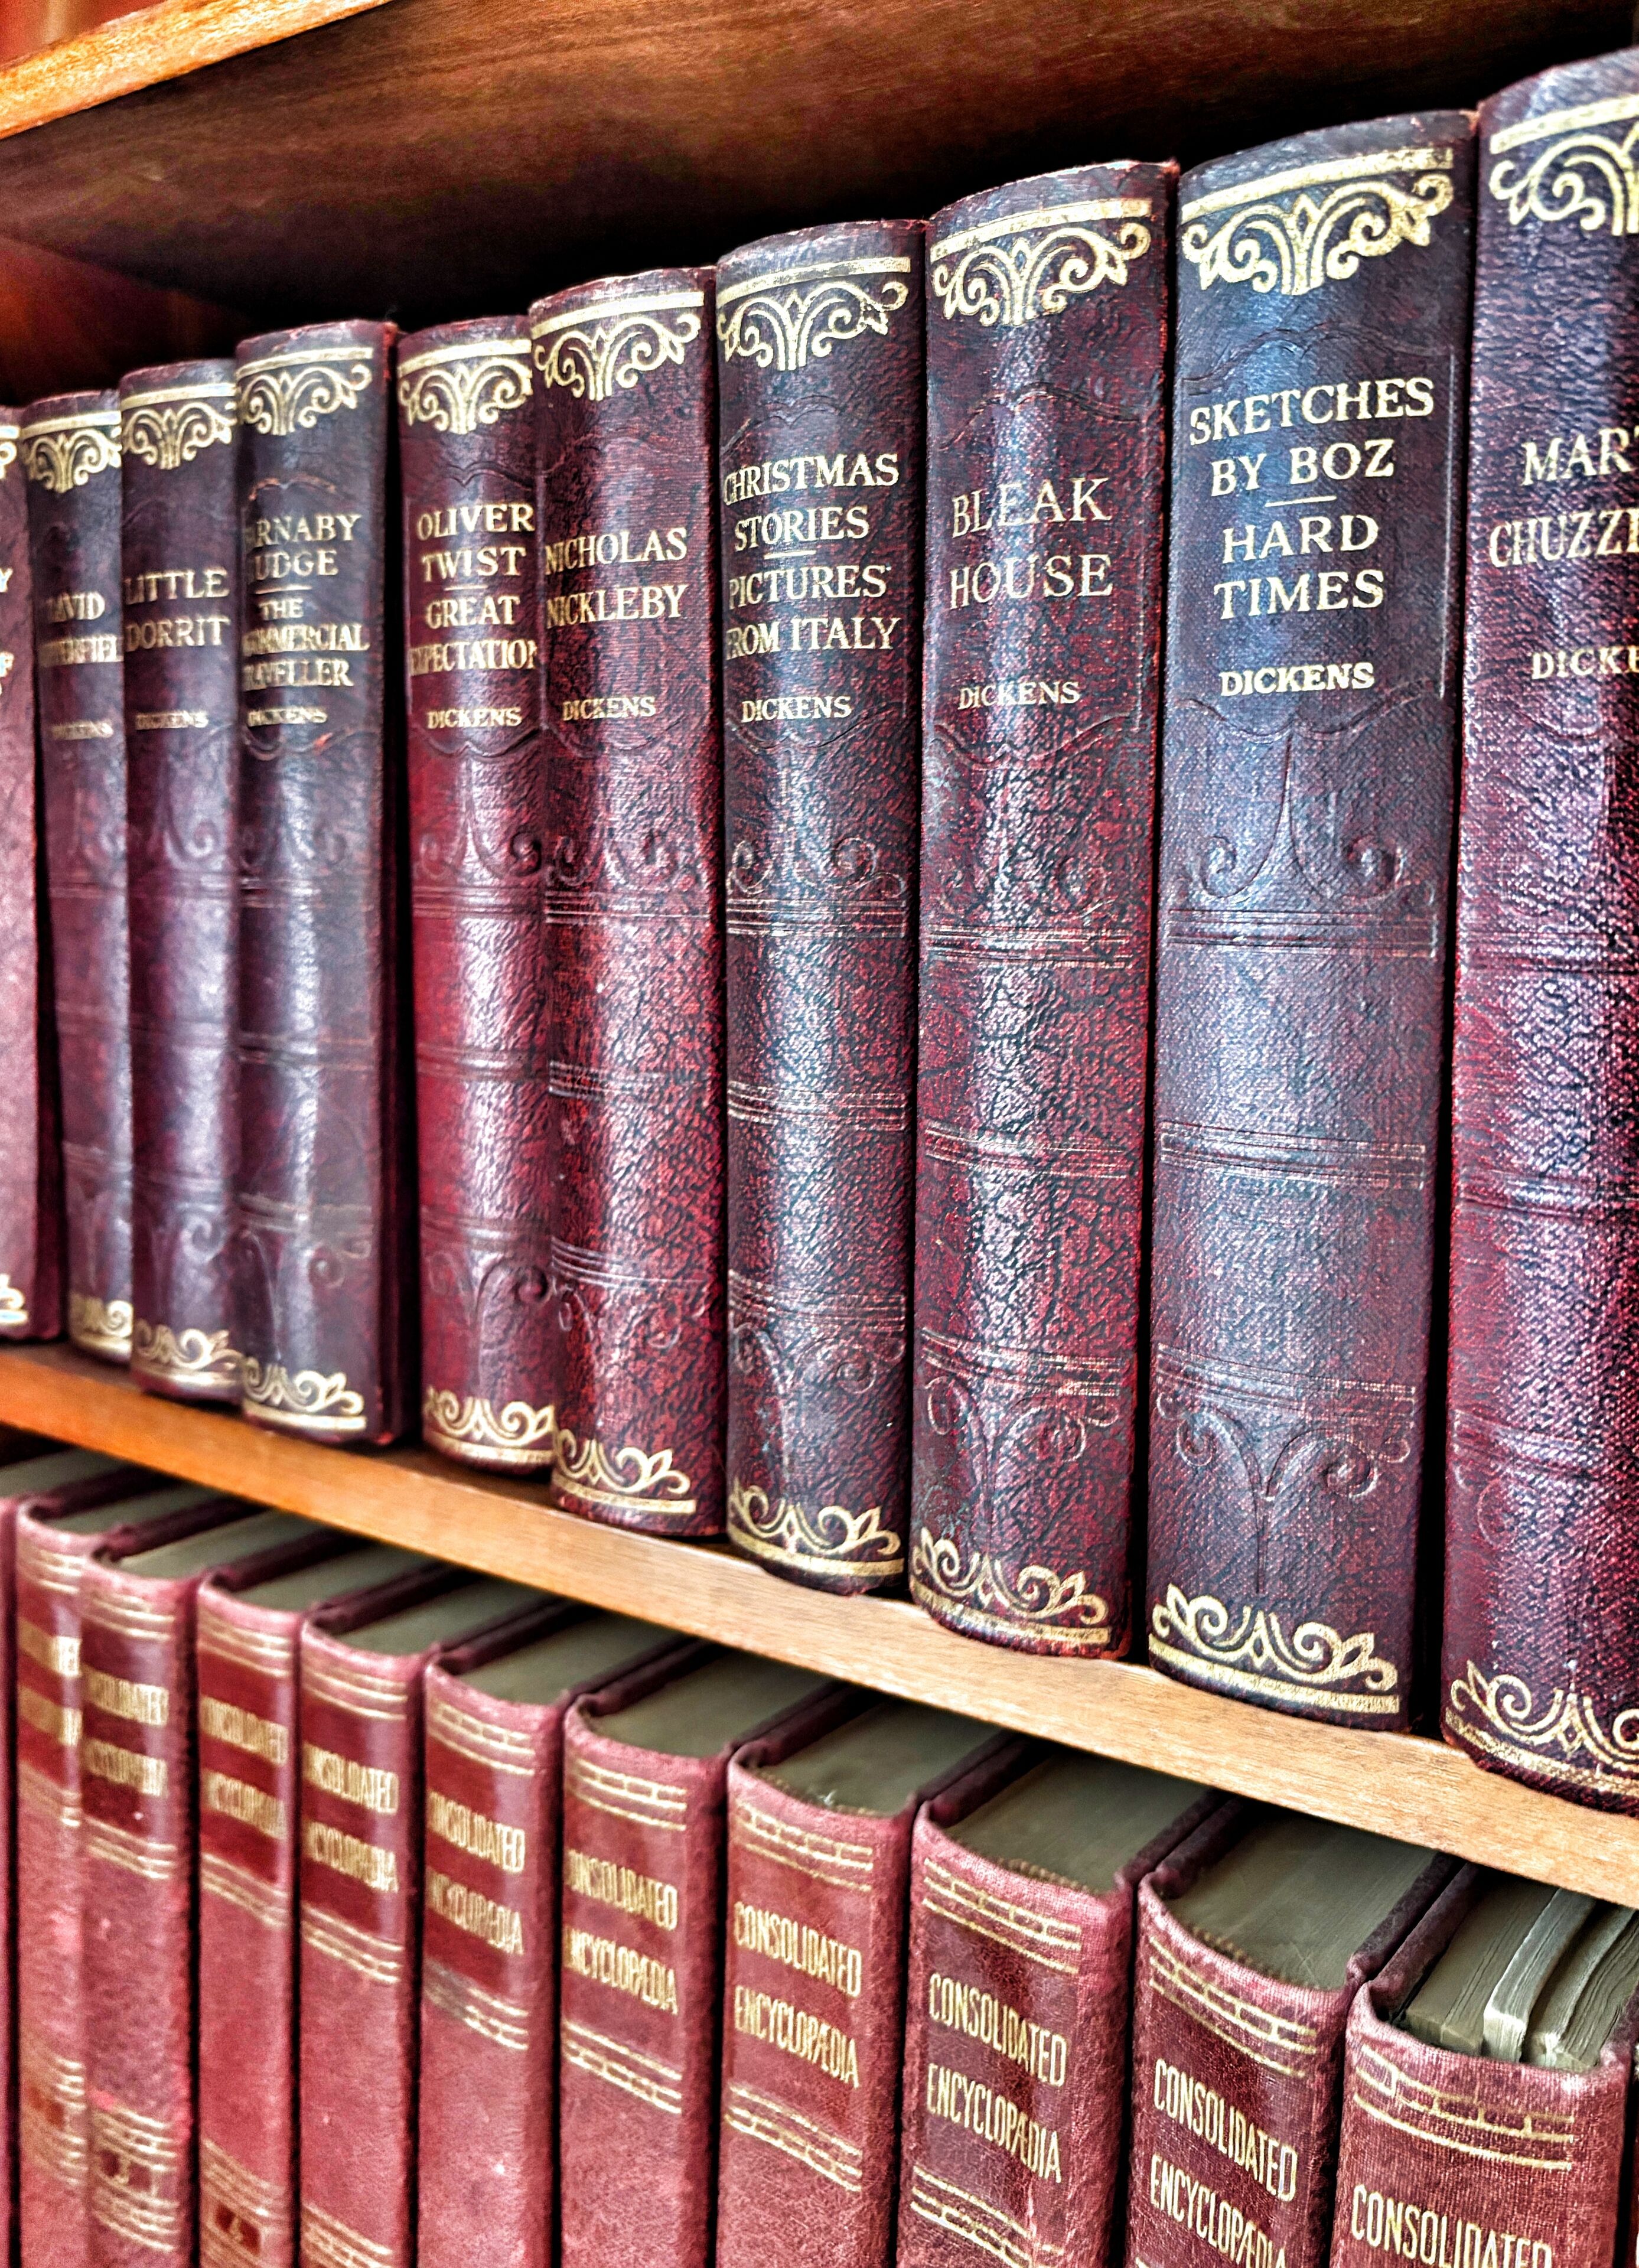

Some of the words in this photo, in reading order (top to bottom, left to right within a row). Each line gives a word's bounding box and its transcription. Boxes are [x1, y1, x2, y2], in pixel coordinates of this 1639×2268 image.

[1190, 377, 1435, 445] SKETCHES
[1210, 452, 1267, 497] BY
[1289, 438, 1394, 487] BOZ
[1521, 425, 1639, 485] MAR
[724, 453, 900, 506] CHRISTMAS
[416, 503, 536, 540] OLIVER
[735, 505, 870, 552] STORIES
[952, 477, 1112, 538] BLEAK
[545, 527, 688, 575] NICHOLAS
[1222, 514, 1380, 564] HARD
[123, 565, 231, 605] LITTLE
[250, 548, 339, 581] UDGE
[421, 546, 527, 582] TWIST
[950, 553, 1114, 610] HOUSE
[258, 597, 304, 620] THE
[546, 585, 688, 629] NICKLEBY
[729, 564, 888, 610] PICTURES
[1214, 569, 1385, 620] TIMES
[125, 614, 232, 652] DORRIT
[425, 595, 521, 630] GREAT
[726, 620, 780, 660] FROM
[790, 616, 902, 651] ITALY
[957, 682, 1081, 711] DICKENS
[1219, 662, 1376, 697] DICKENS
[427, 706, 523, 729] DICKENS
[562, 696, 657, 721] DICKENS
[741, 695, 852, 723] DICKENS
[734, 1901, 862, 1997] CONSOLIDATED
[929, 1972, 1067, 2087] CONSOLIDATED
[1154, 2058, 1298, 2202] CONSOLIDATED
